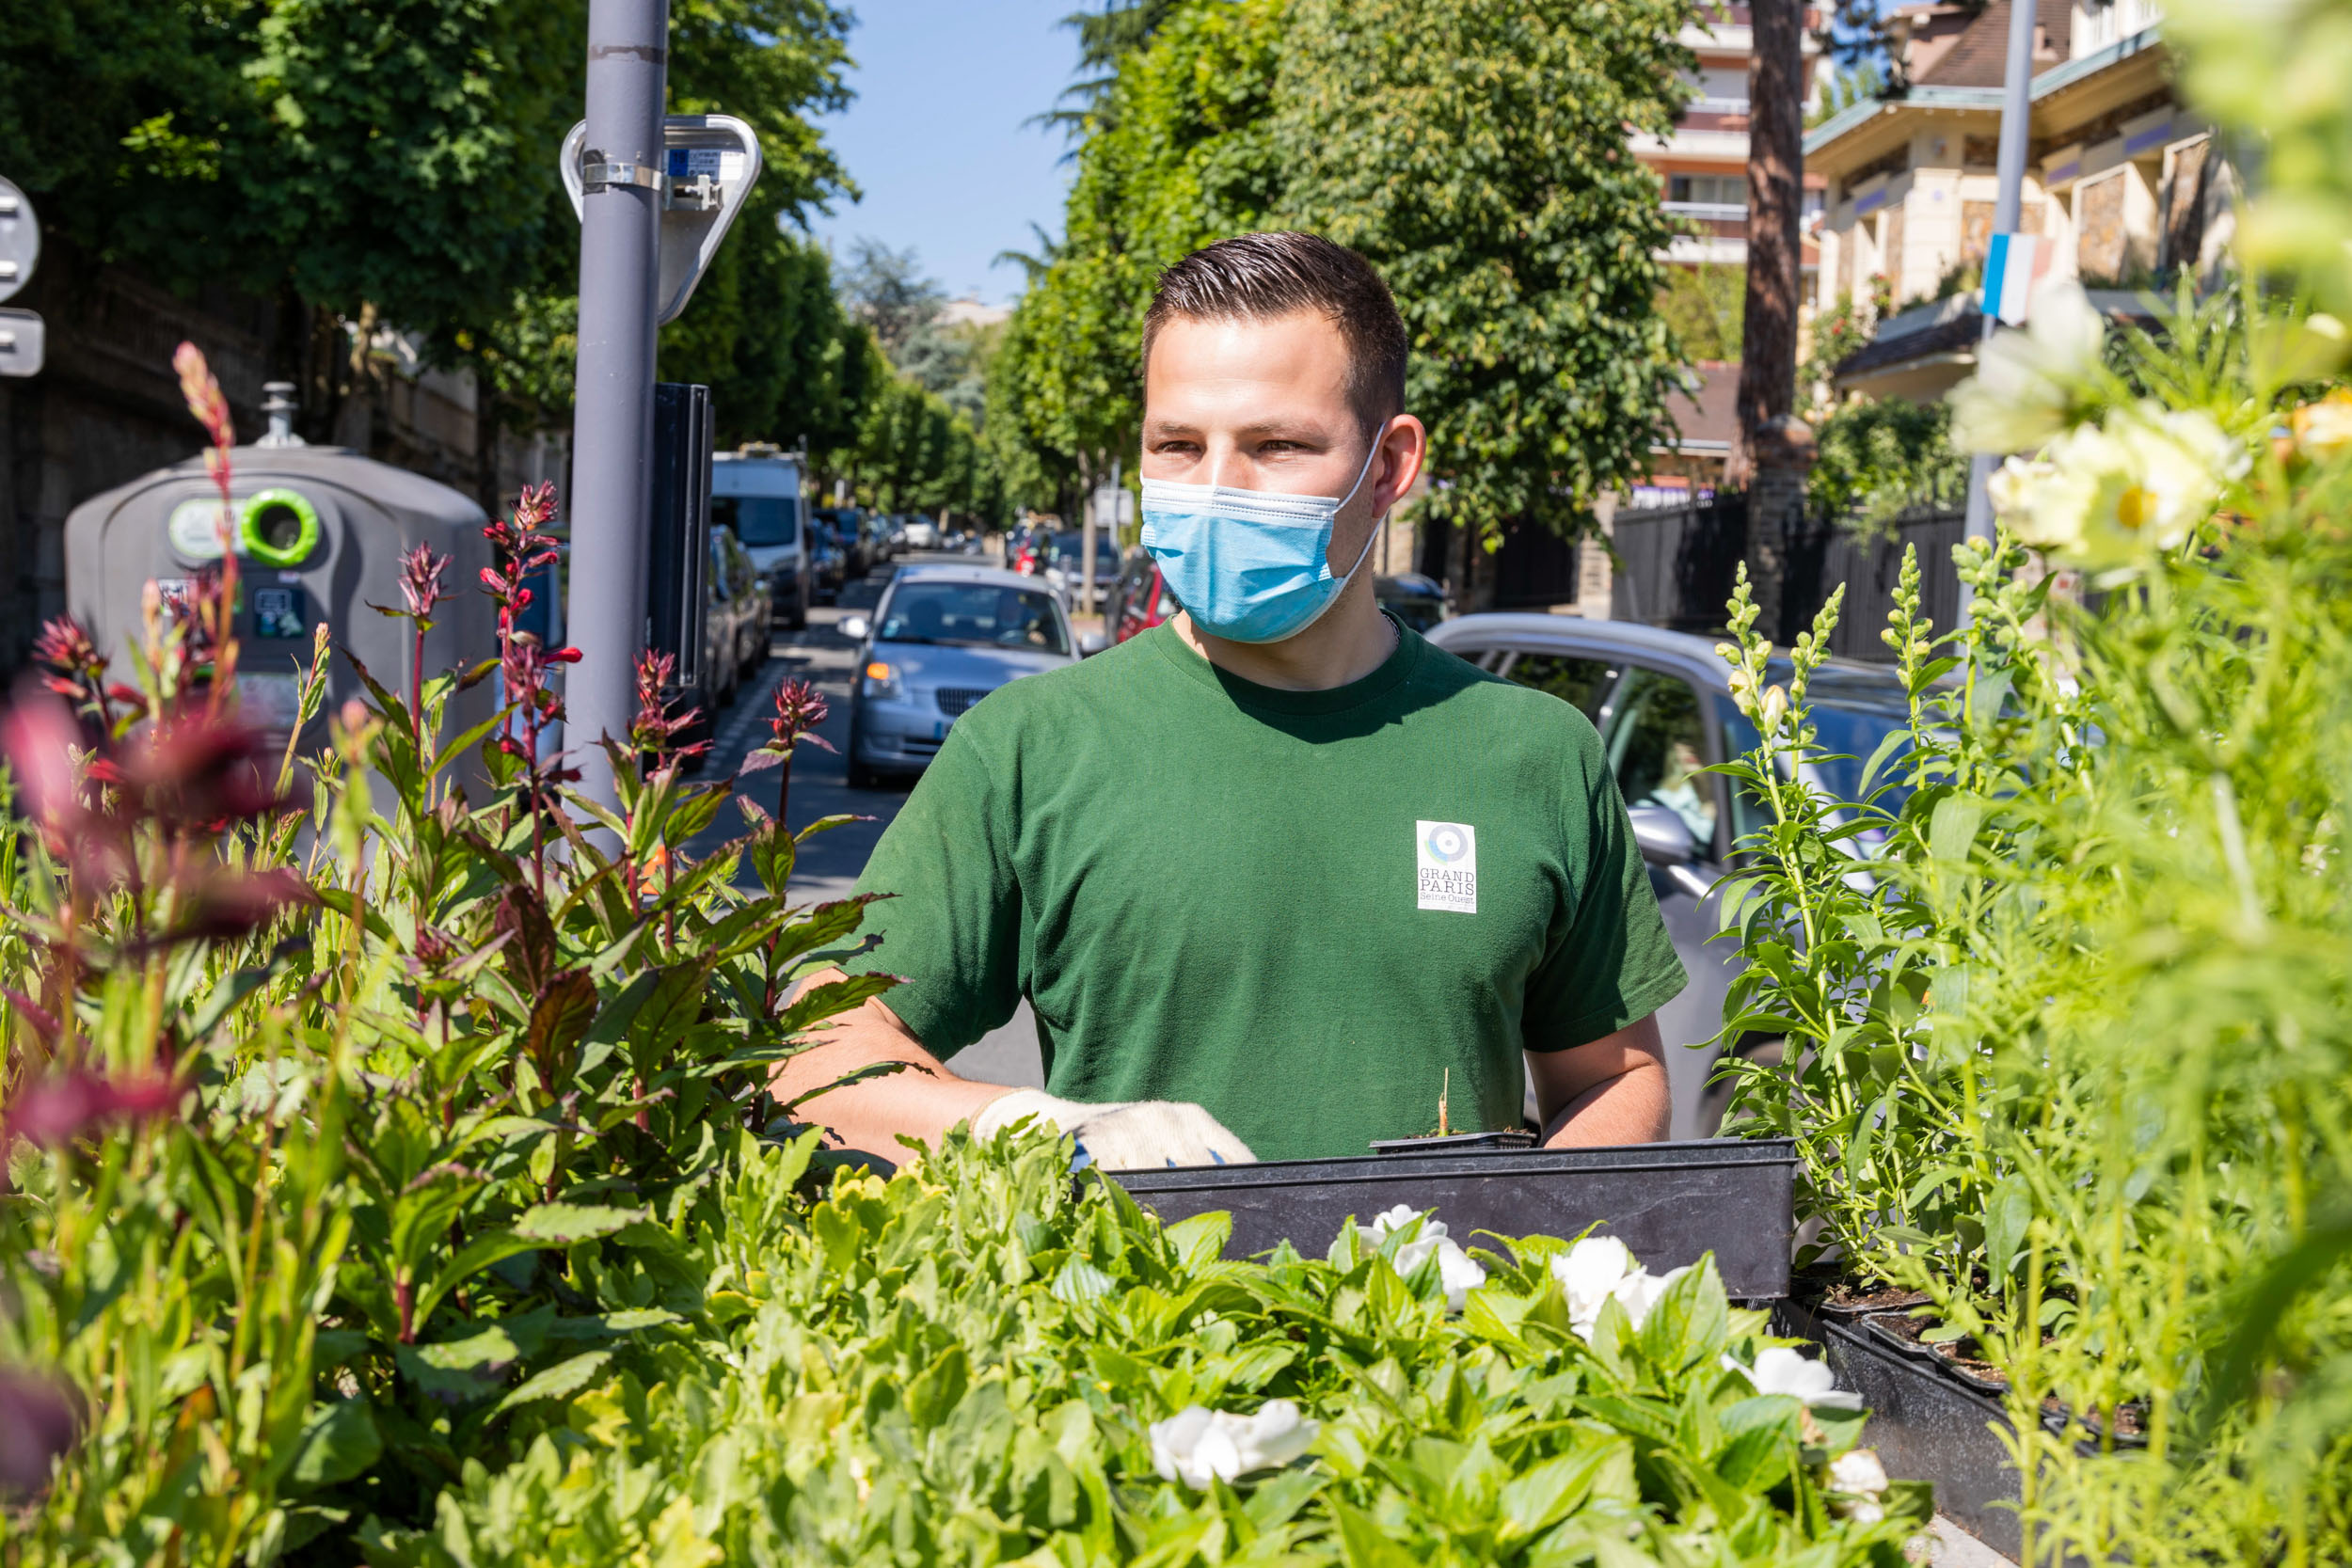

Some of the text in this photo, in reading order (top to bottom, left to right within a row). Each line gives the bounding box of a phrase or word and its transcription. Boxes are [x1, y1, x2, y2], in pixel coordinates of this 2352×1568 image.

[1420, 867, 1474, 882] GRAND
[1420, 879, 1474, 895] PARIS
[1420, 892, 1475, 904] Seine Ouest
